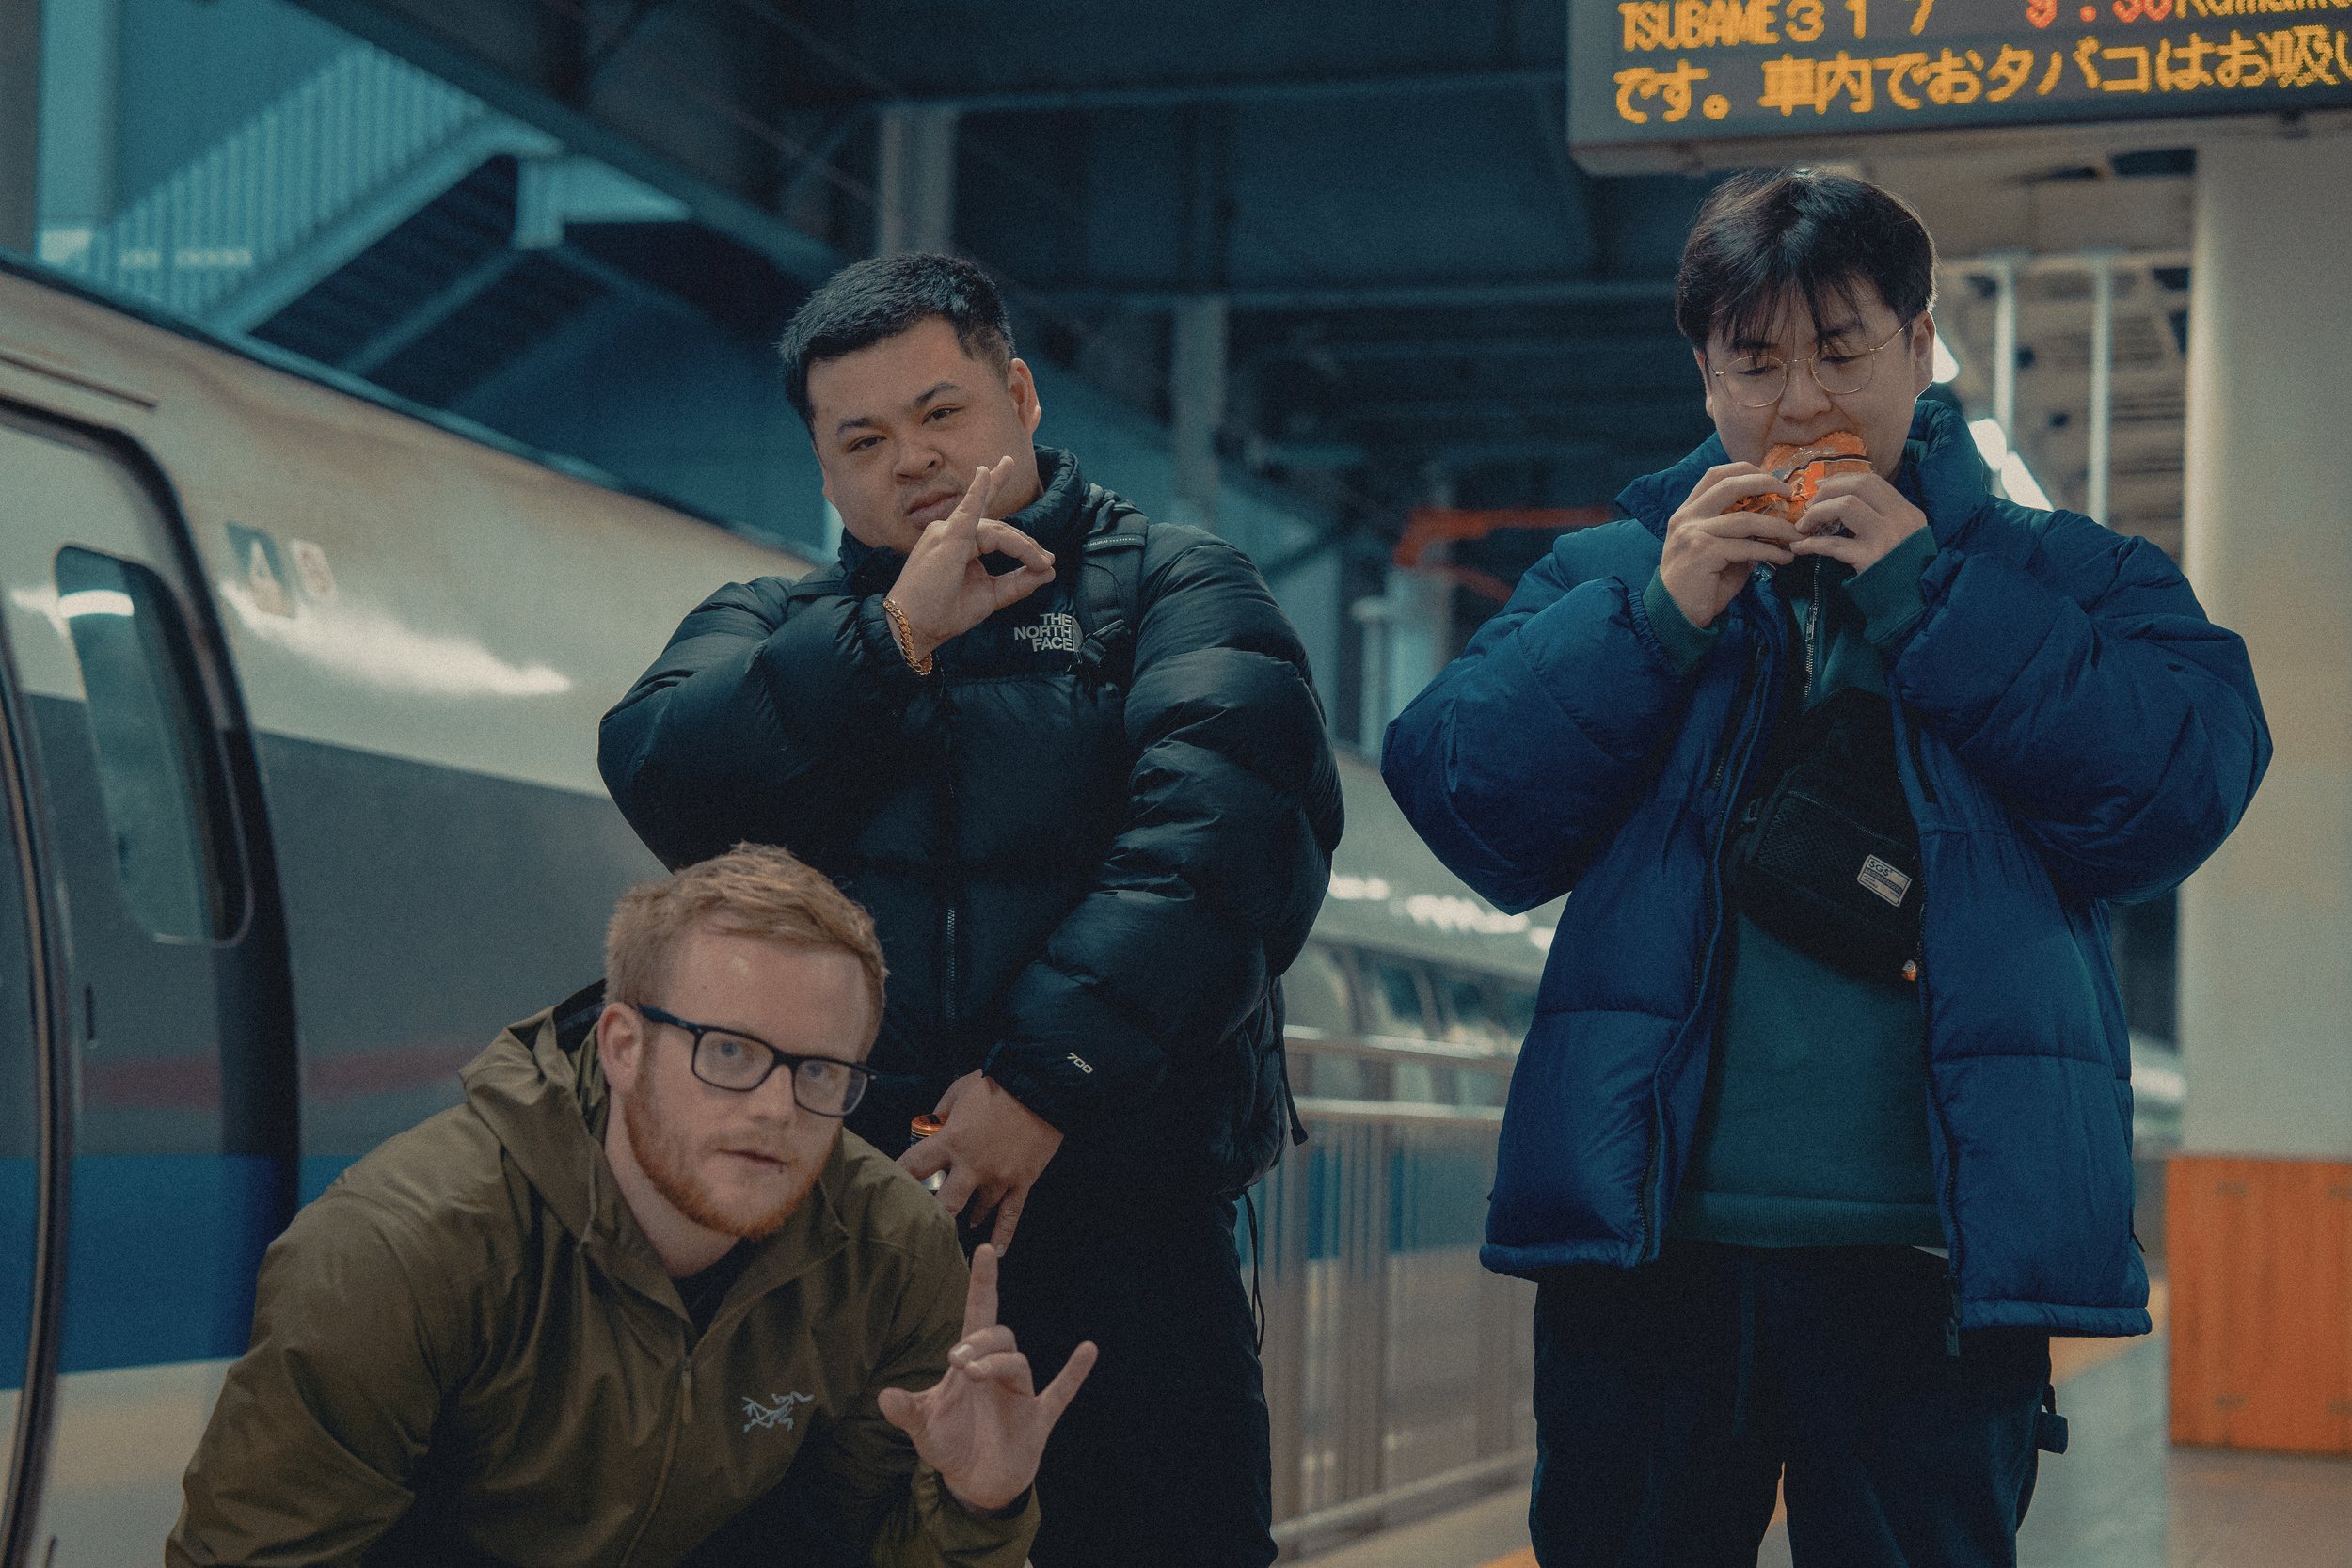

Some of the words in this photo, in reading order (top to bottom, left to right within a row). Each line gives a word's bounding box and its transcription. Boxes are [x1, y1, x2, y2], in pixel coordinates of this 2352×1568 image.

[1617, 0, 1780, 51] TSUBAME
[1040, 613, 1073, 625] THE
[1014, 626, 1072, 640] NORTH
[1032, 636, 1073, 652] FACE
[1067, 1052, 1093, 1074] 700
